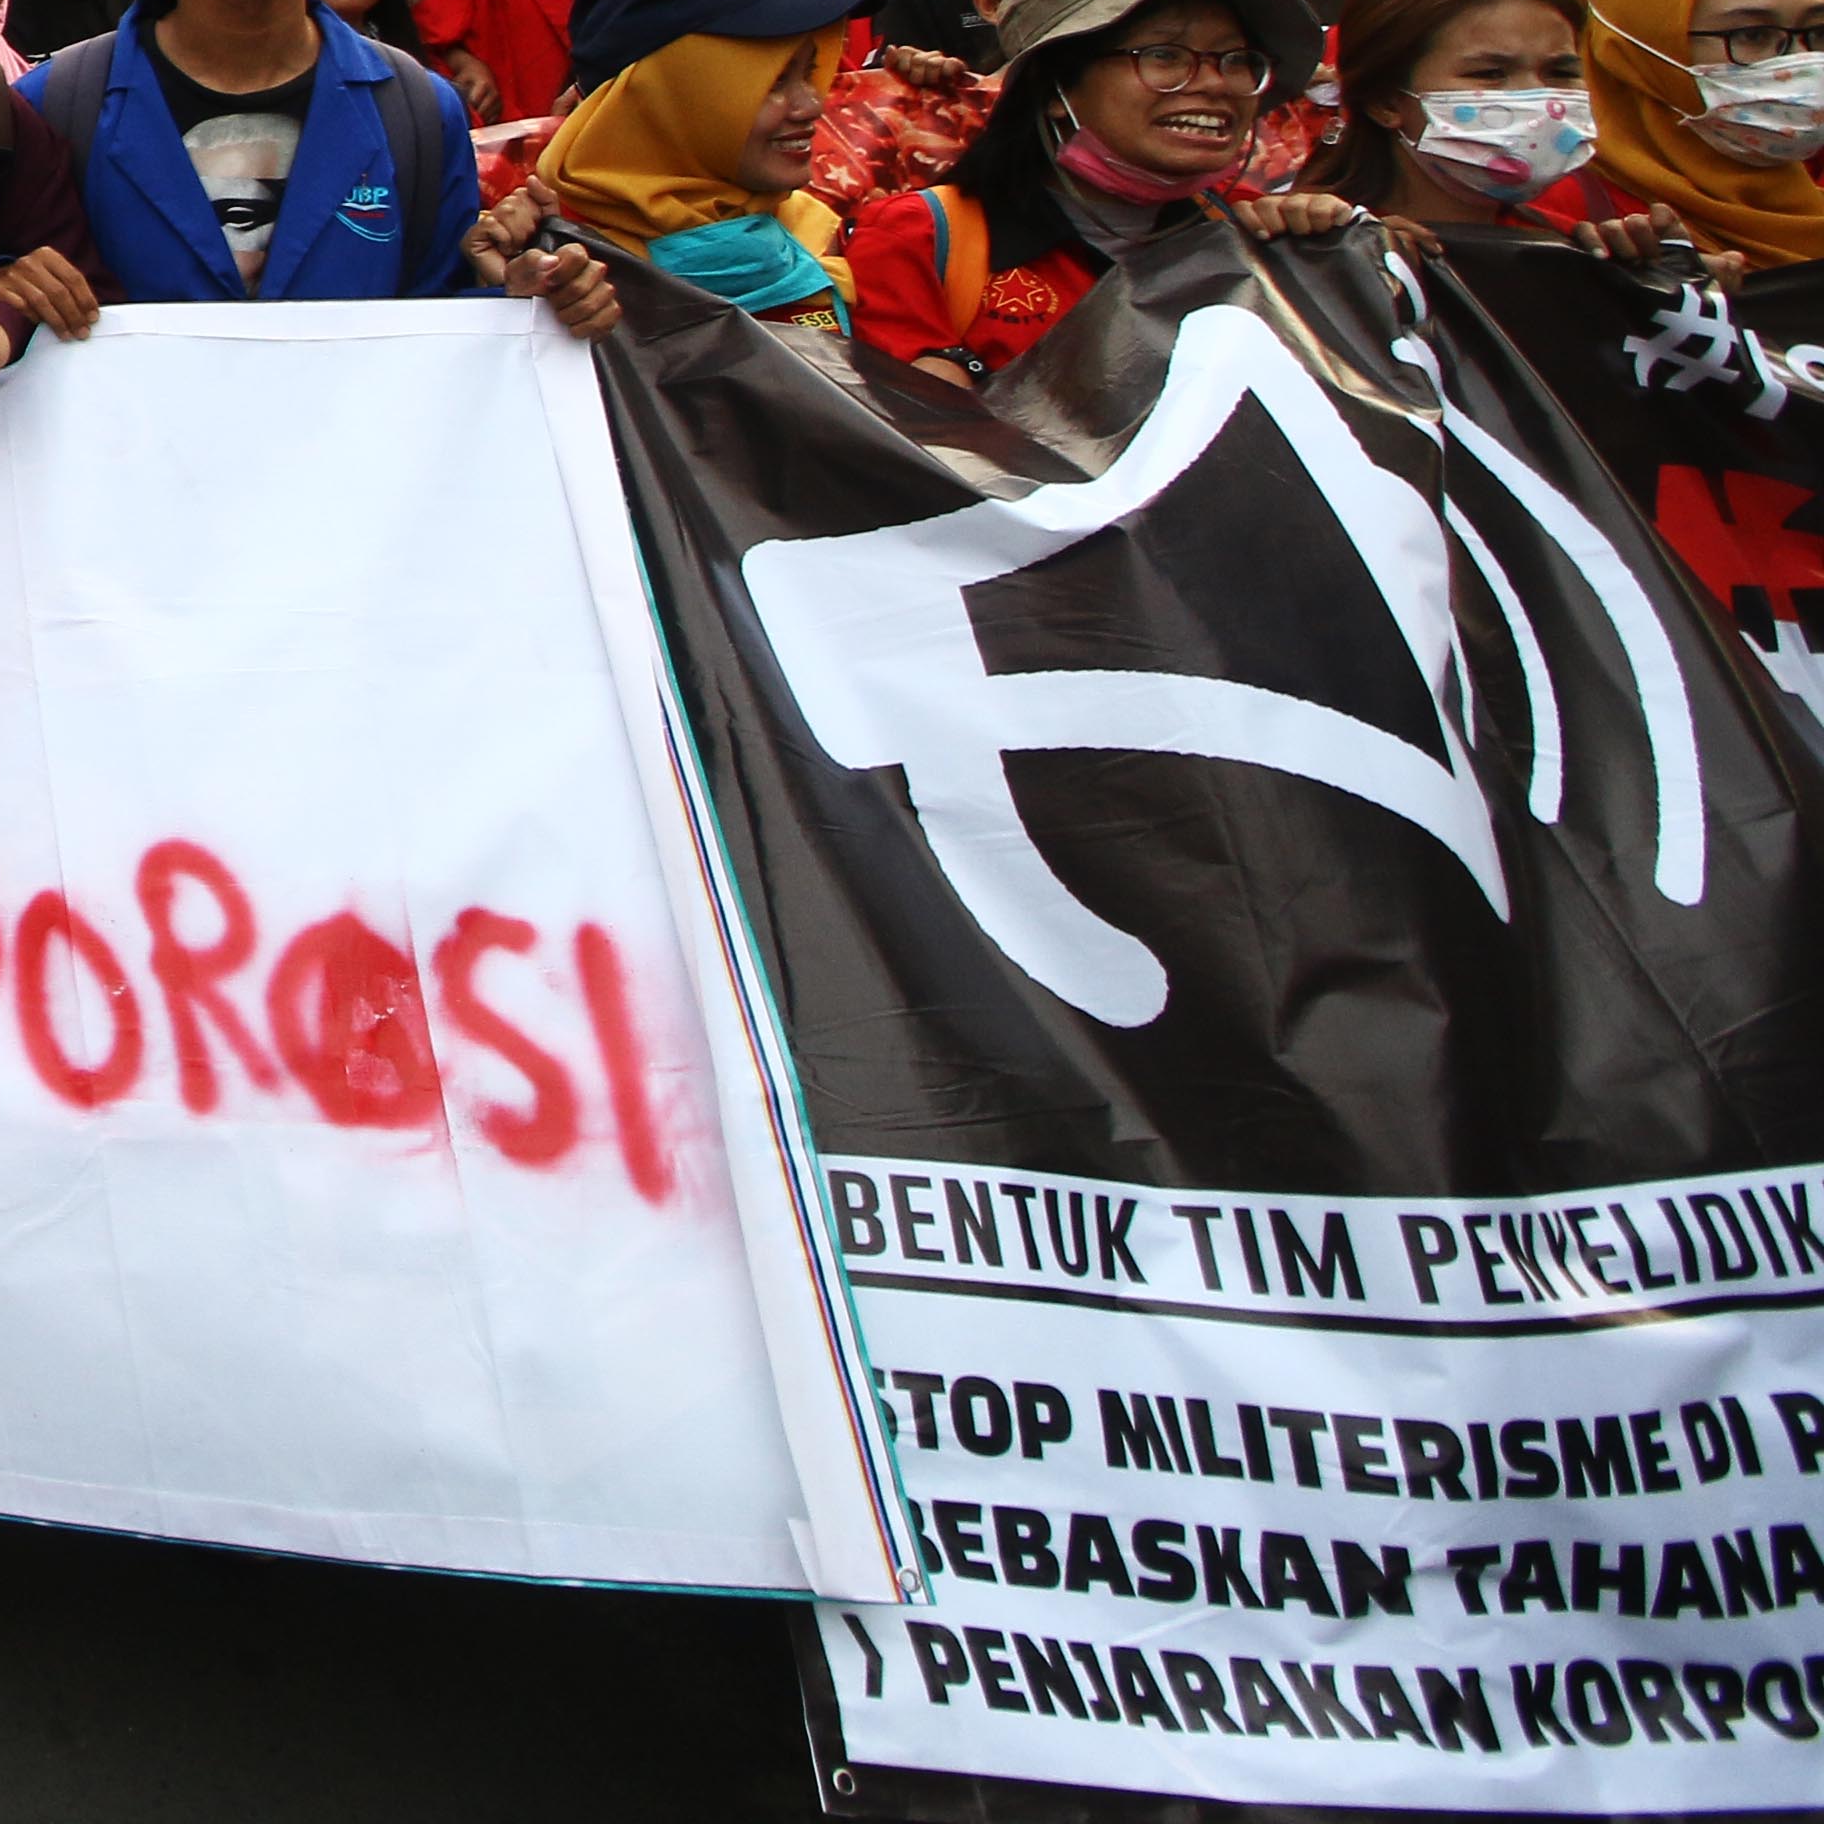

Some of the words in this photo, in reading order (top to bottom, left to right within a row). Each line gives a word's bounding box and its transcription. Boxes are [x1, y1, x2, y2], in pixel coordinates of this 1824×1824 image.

[829, 1168, 1149, 1287] BENTUK
[1170, 1202, 1367, 1302] TIM
[1097, 1388, 1683, 1502] MILITERISME
[1682, 1394, 1763, 1486] DI
[1444, 1522, 1824, 1620] TAHANA
[904, 1615, 1503, 1754] PENJARAKAN
